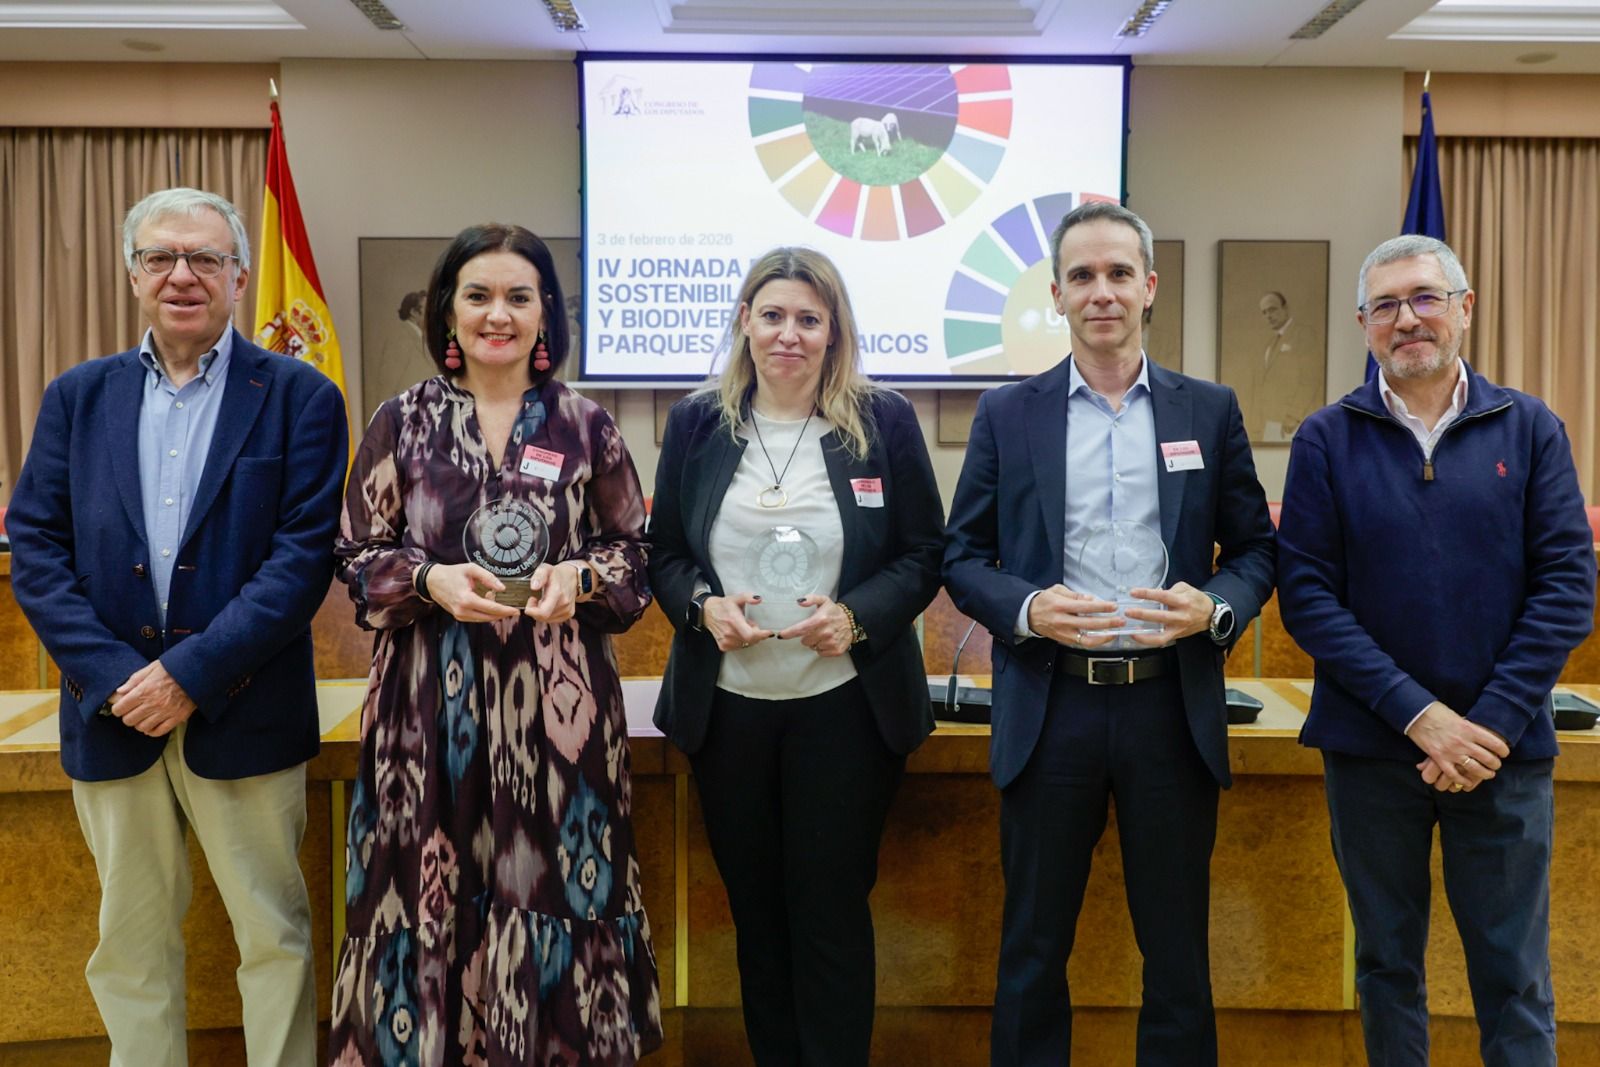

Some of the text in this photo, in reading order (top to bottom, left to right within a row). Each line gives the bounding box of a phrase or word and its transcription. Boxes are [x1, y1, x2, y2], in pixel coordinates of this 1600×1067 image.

[597, 233, 733, 246] 3 de febrero de 2026
[598, 258, 621, 278] IV
[627, 258, 742, 278] JORNADA
[598, 283, 738, 304] SOSTENIBIL
[598, 309, 614, 328] Y
[598, 334, 715, 356] PARQUES
[473, 550, 521, 576] Sostenibilidad
